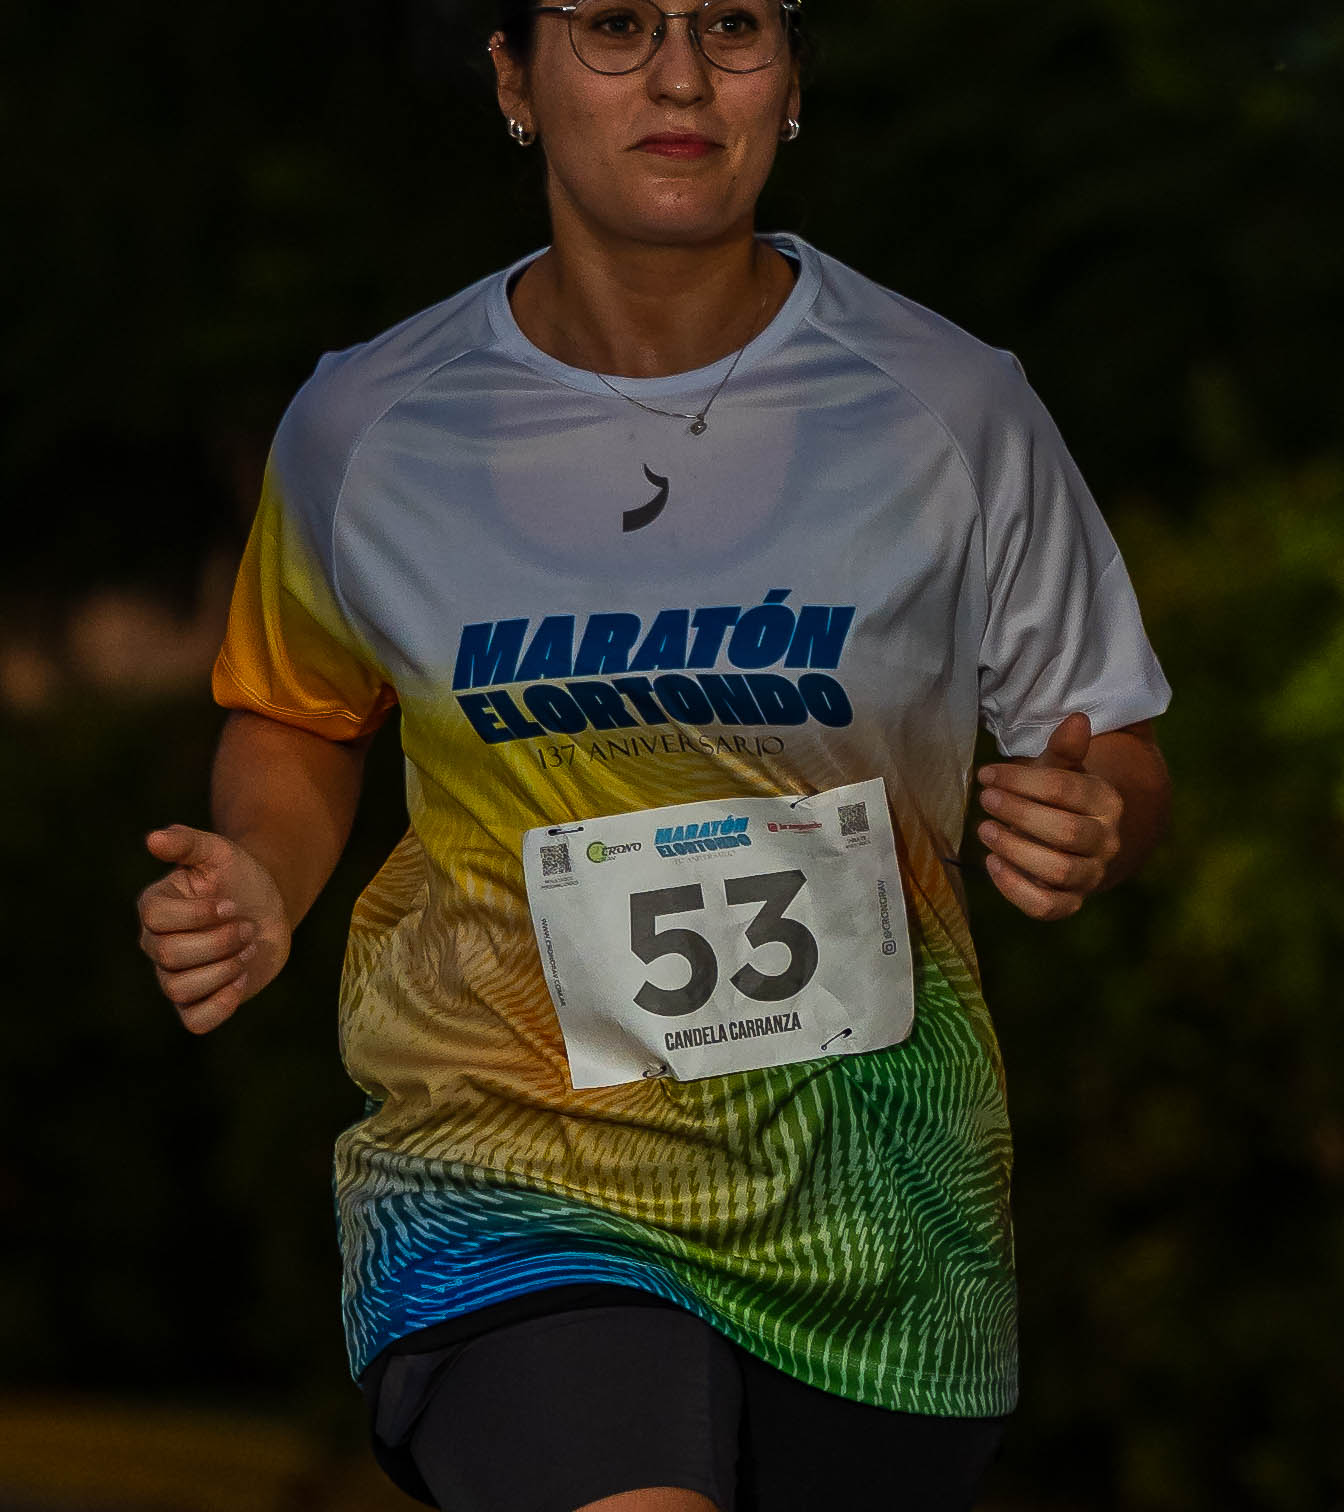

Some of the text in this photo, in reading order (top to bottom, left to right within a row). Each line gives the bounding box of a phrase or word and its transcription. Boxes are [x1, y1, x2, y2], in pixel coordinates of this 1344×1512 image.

[452, 589, 856, 691] MARATÓN
[455, 673, 854, 745] ELORTONDO
[537, 733, 785, 770] 137 ANIVERSARIO
[630, 869, 819, 1016] 53
[664, 1011, 802, 1051] CANDELA CARRANZA
